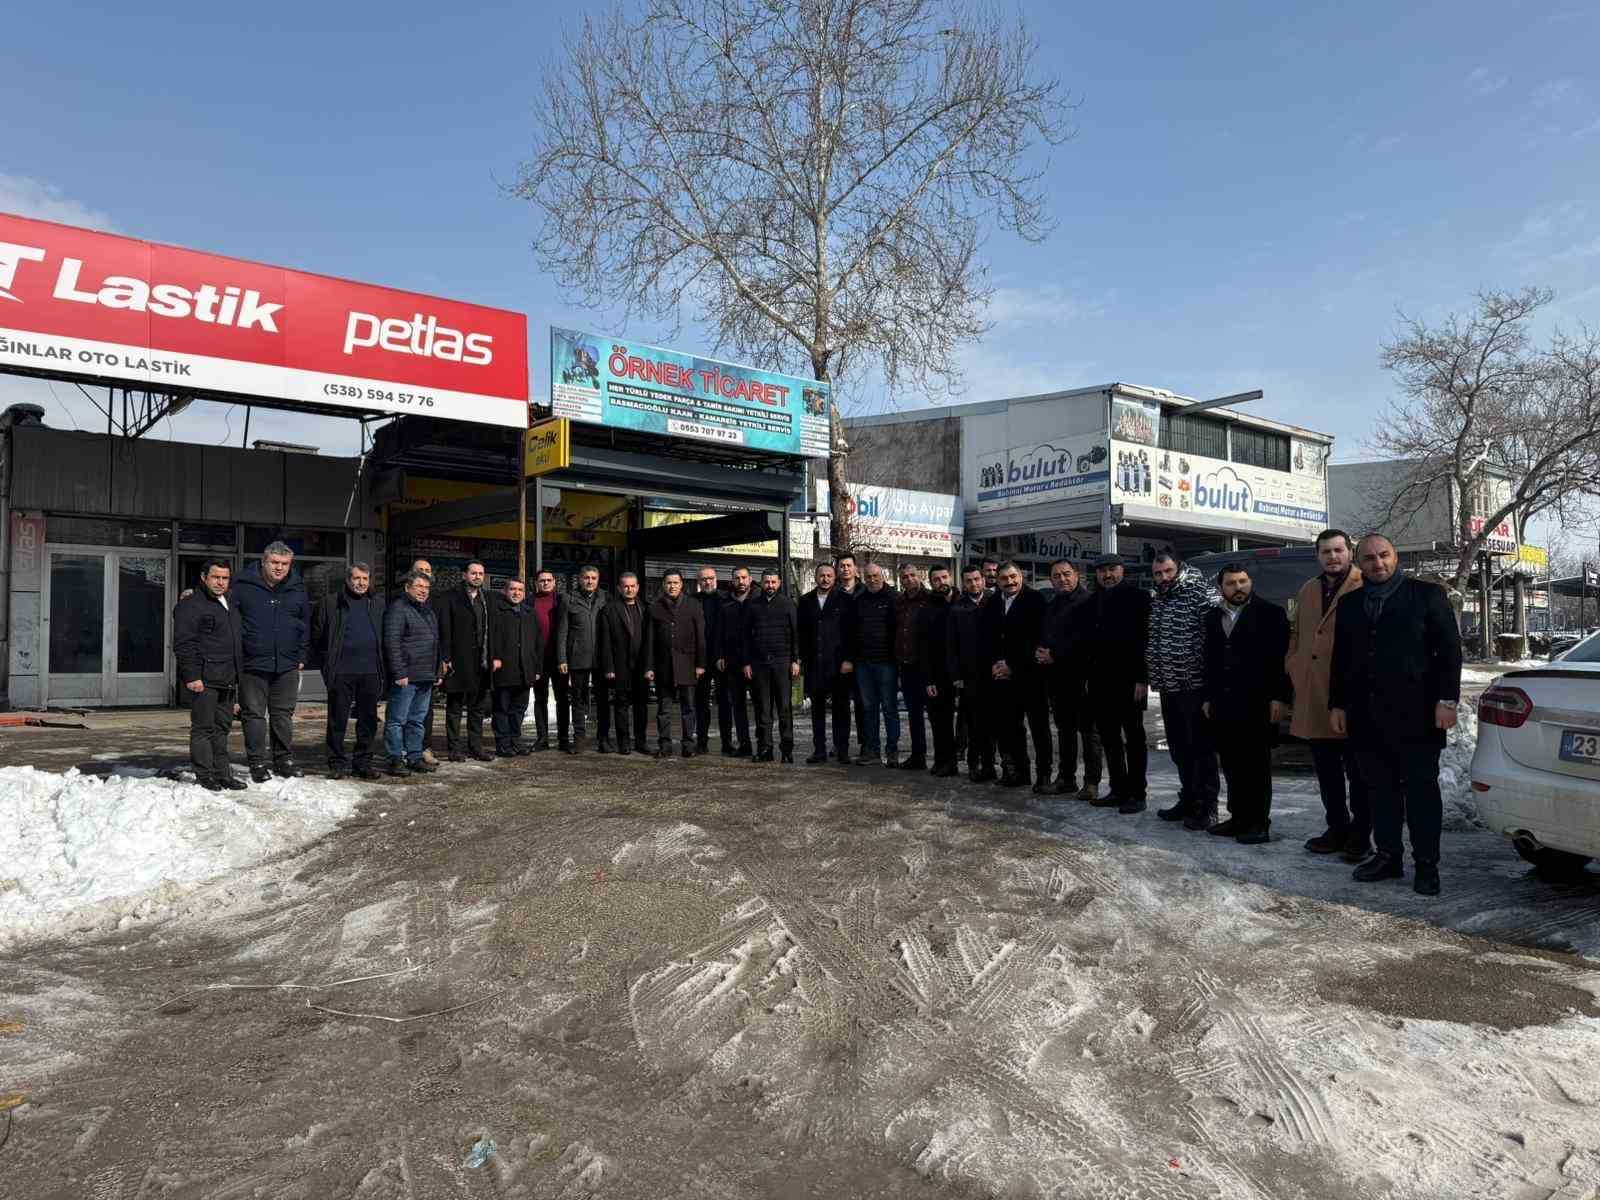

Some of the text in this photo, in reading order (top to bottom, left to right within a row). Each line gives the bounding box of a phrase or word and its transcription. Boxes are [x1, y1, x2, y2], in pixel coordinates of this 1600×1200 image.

[53, 257, 285, 333] Lastik
[344, 312, 493, 365] petlas
[78, 350, 119, 366] OTO
[124, 356, 192, 376] LASTİK
[608, 344, 789, 407] ÖRNEK TİCARET
[323, 384, 434, 408] (538) 594 57 76
[609, 384, 624, 393] HER
[650, 391, 672, 402] YEDEK
[674, 395, 696, 406] PARÇA
[670, 407, 693, 418] KAAN
[1008, 454, 1067, 482] bulut
[1194, 472, 1250, 513] bulut
[1039, 538, 1078, 558] bulut
[1574, 736, 1597, 756] 23
